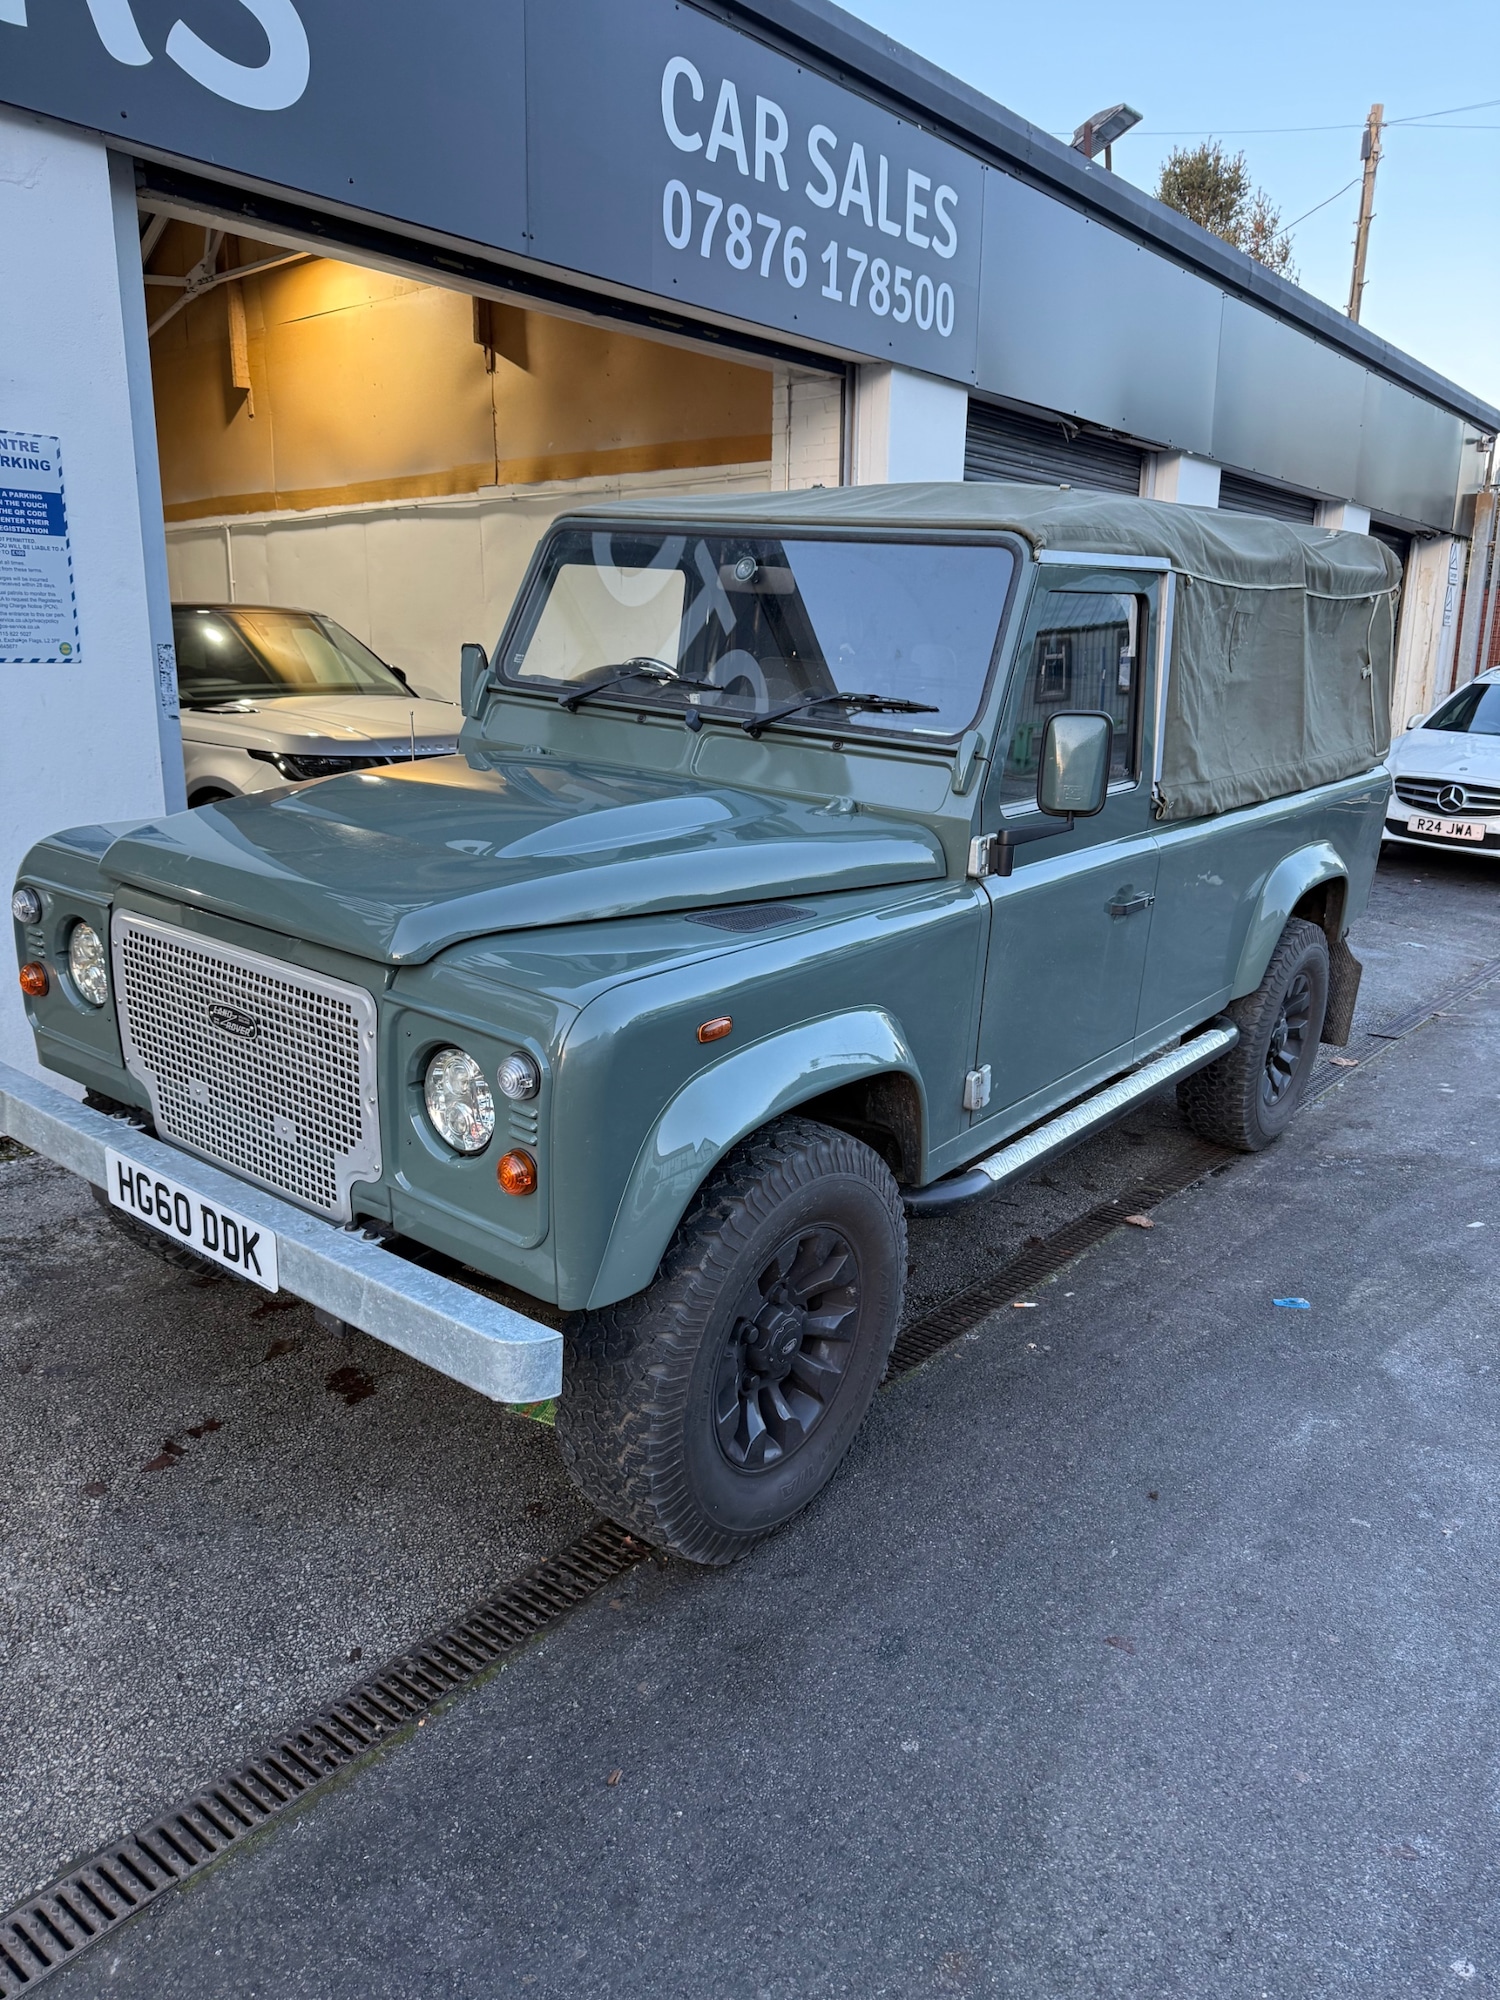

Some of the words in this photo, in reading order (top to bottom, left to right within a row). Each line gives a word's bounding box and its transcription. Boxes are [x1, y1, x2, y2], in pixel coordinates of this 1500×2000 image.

[661, 56, 790, 191] CAR
[805, 124, 959, 259] SALES
[662, 179, 808, 288] 07876
[821, 241, 955, 337] 178500
[0, 455, 51, 471] RKING
[9, 491, 43, 500] PARKING
[21, 501, 48, 509] TOUCH
[0, 516, 25, 524] ENTER
[26, 518, 49, 526] THEIR
[26, 510, 48, 518] CODE
[1417, 818, 1442, 833] R24
[1446, 823, 1472, 837] JWA
[117, 1160, 192, 1238] HG60
[200, 1203, 262, 1277] DDK
